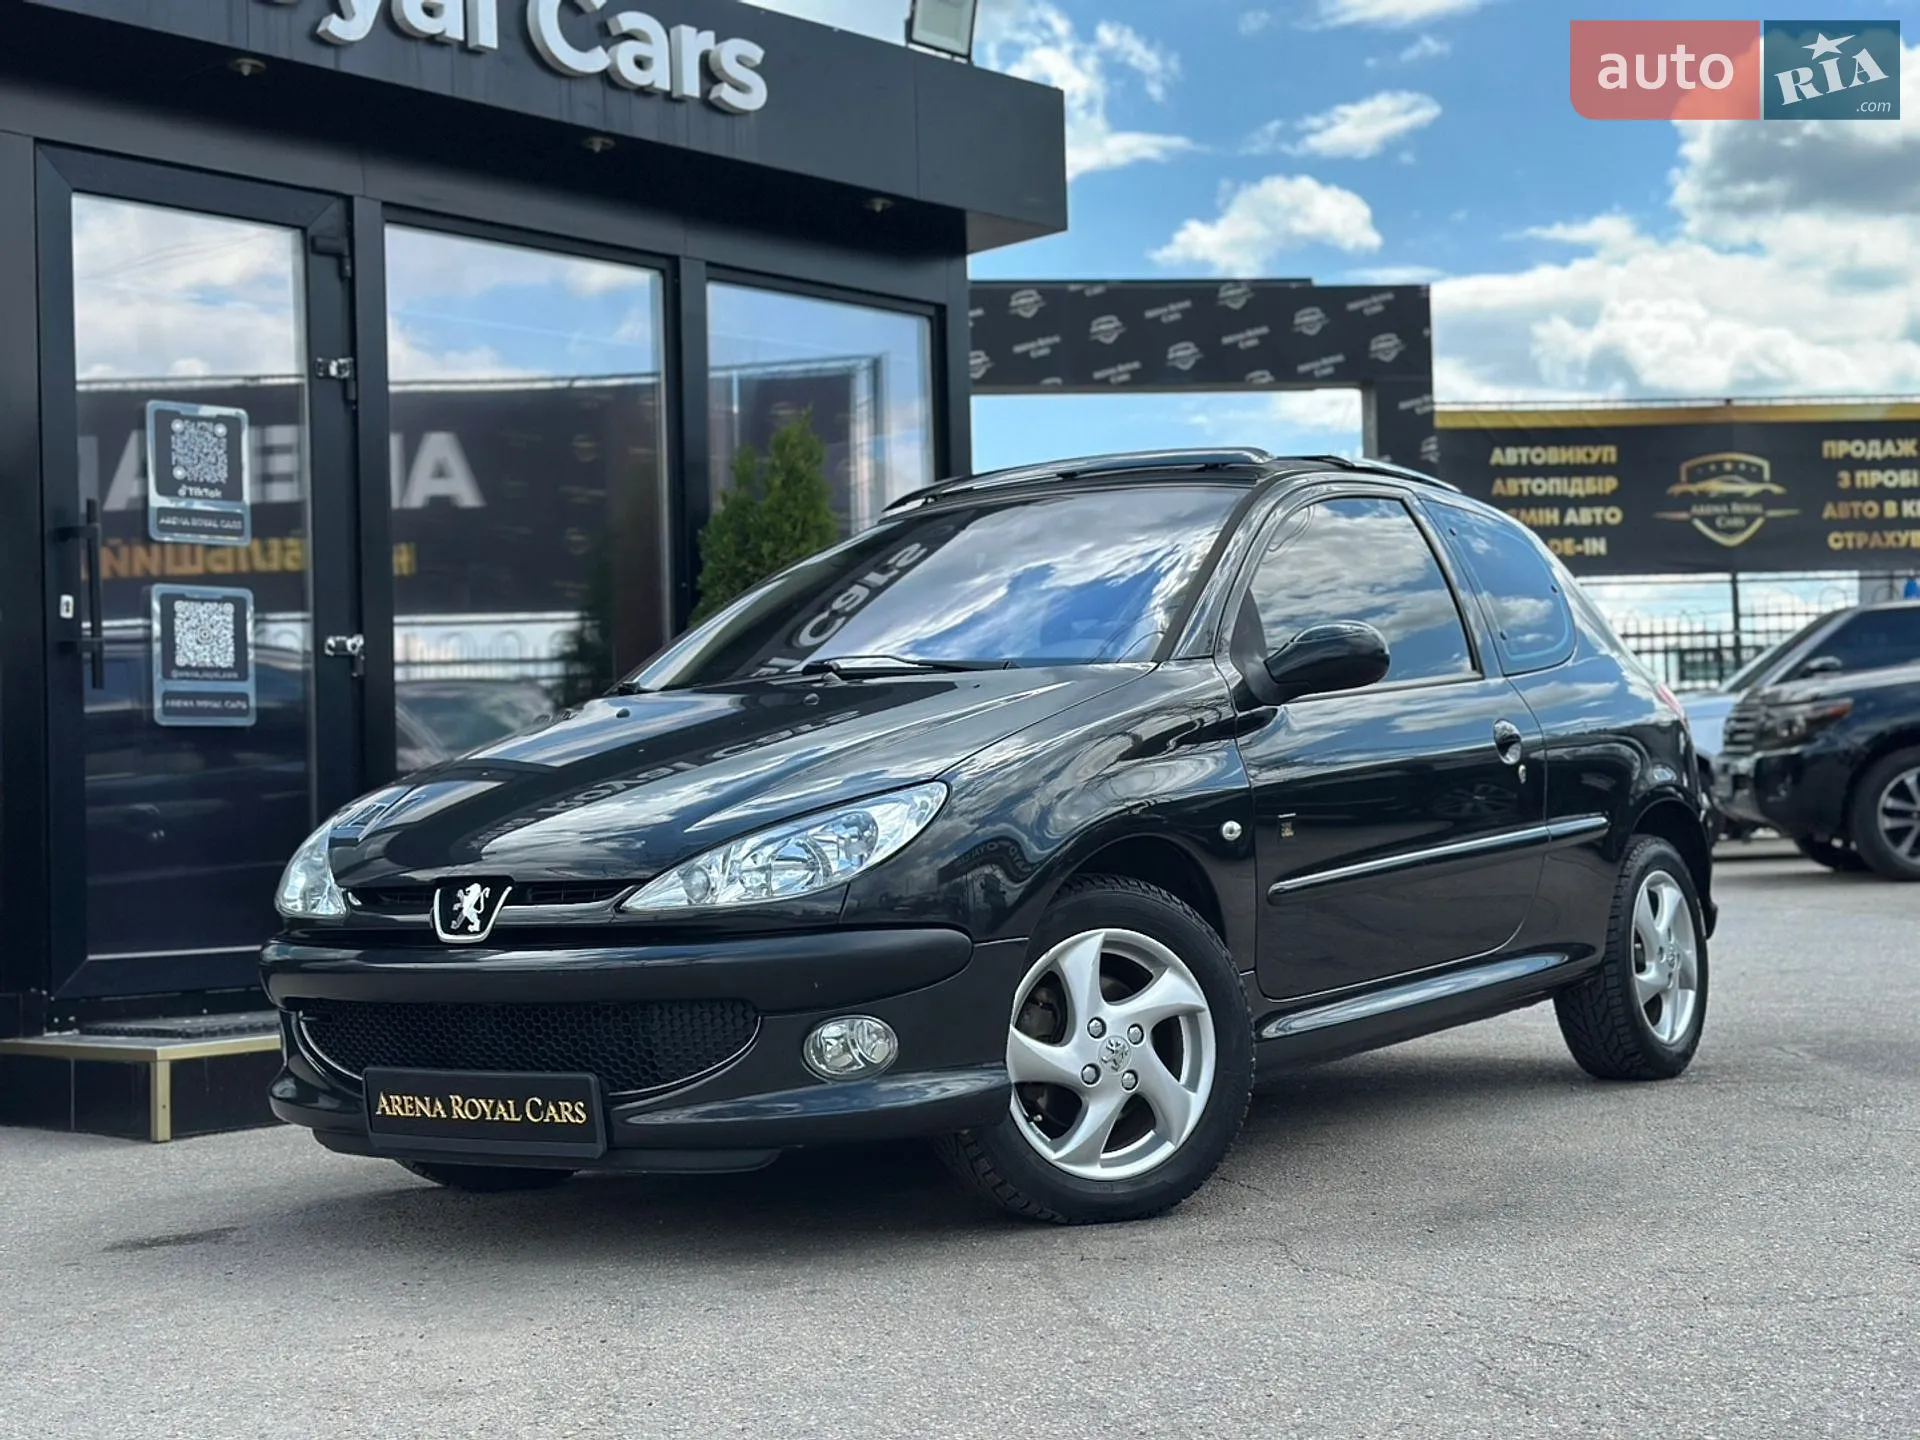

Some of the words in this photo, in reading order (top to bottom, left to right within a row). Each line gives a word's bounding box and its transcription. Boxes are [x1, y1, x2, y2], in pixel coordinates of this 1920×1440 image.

[526, 0, 768, 114] Cars
[1489, 446, 1617, 466] АВТОВИКУП
[1822, 439, 1918, 461] ПРОДАЖ
[1491, 476, 1618, 498] АВТОПІДБІР
[1507, 507, 1559, 526] МІН
[1563, 505, 1623, 525] АВТО
[1822, 501, 1879, 520] АВТО
[1547, 536, 1608, 557] DE-IN
[376, 1091, 447, 1119] ARENA
[449, 1094, 522, 1122] ROYAL
[525, 1096, 587, 1124] CARS
